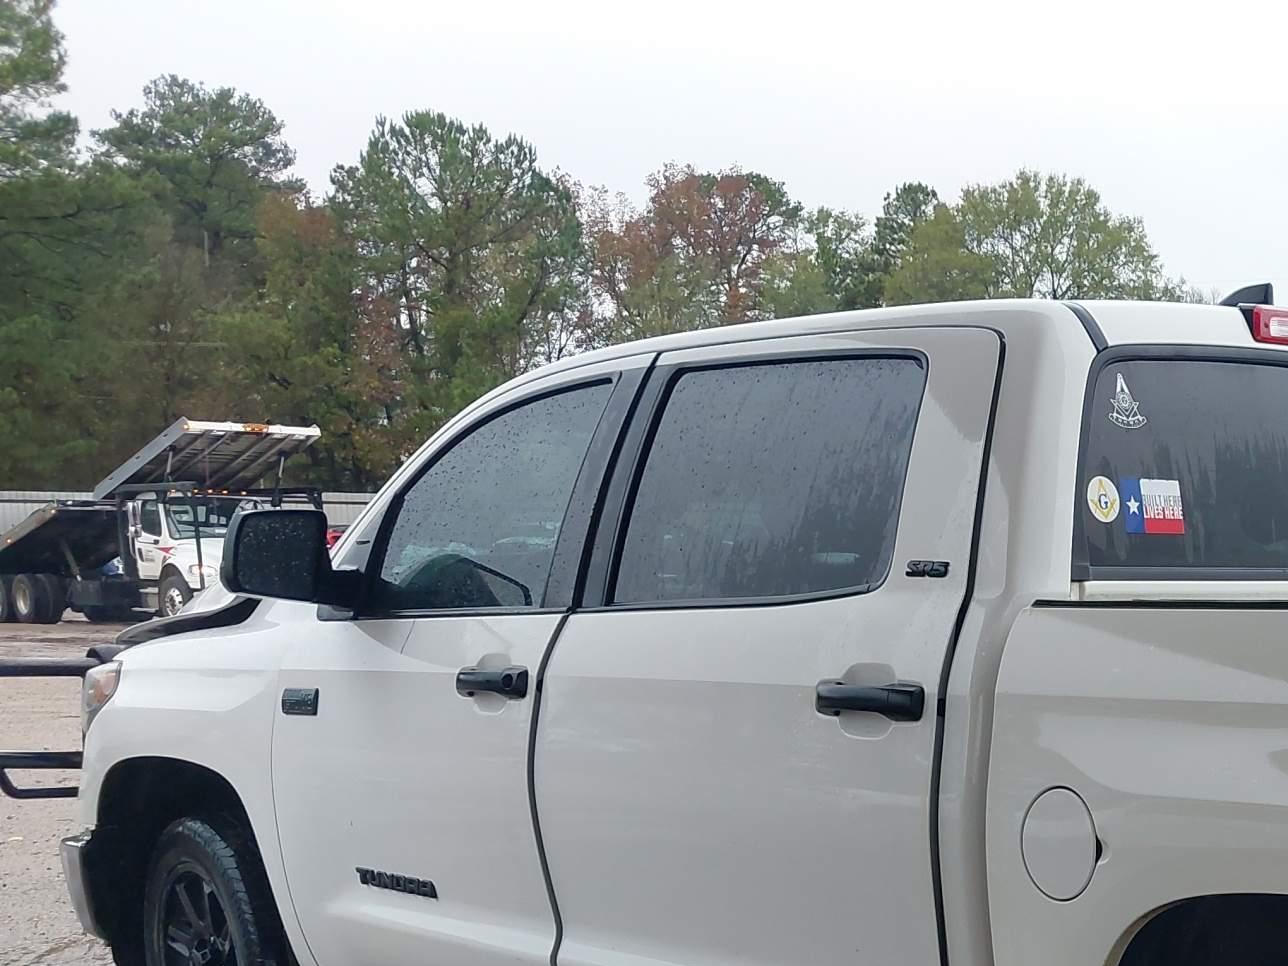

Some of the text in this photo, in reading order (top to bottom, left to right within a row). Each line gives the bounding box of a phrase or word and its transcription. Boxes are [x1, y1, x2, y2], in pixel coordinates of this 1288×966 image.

[1098, 493, 1109, 509] G
[1144, 505, 1184, 520] LIVES HERE
[905, 560, 950, 578] SR5
[355, 866, 438, 899] TUNDRA
